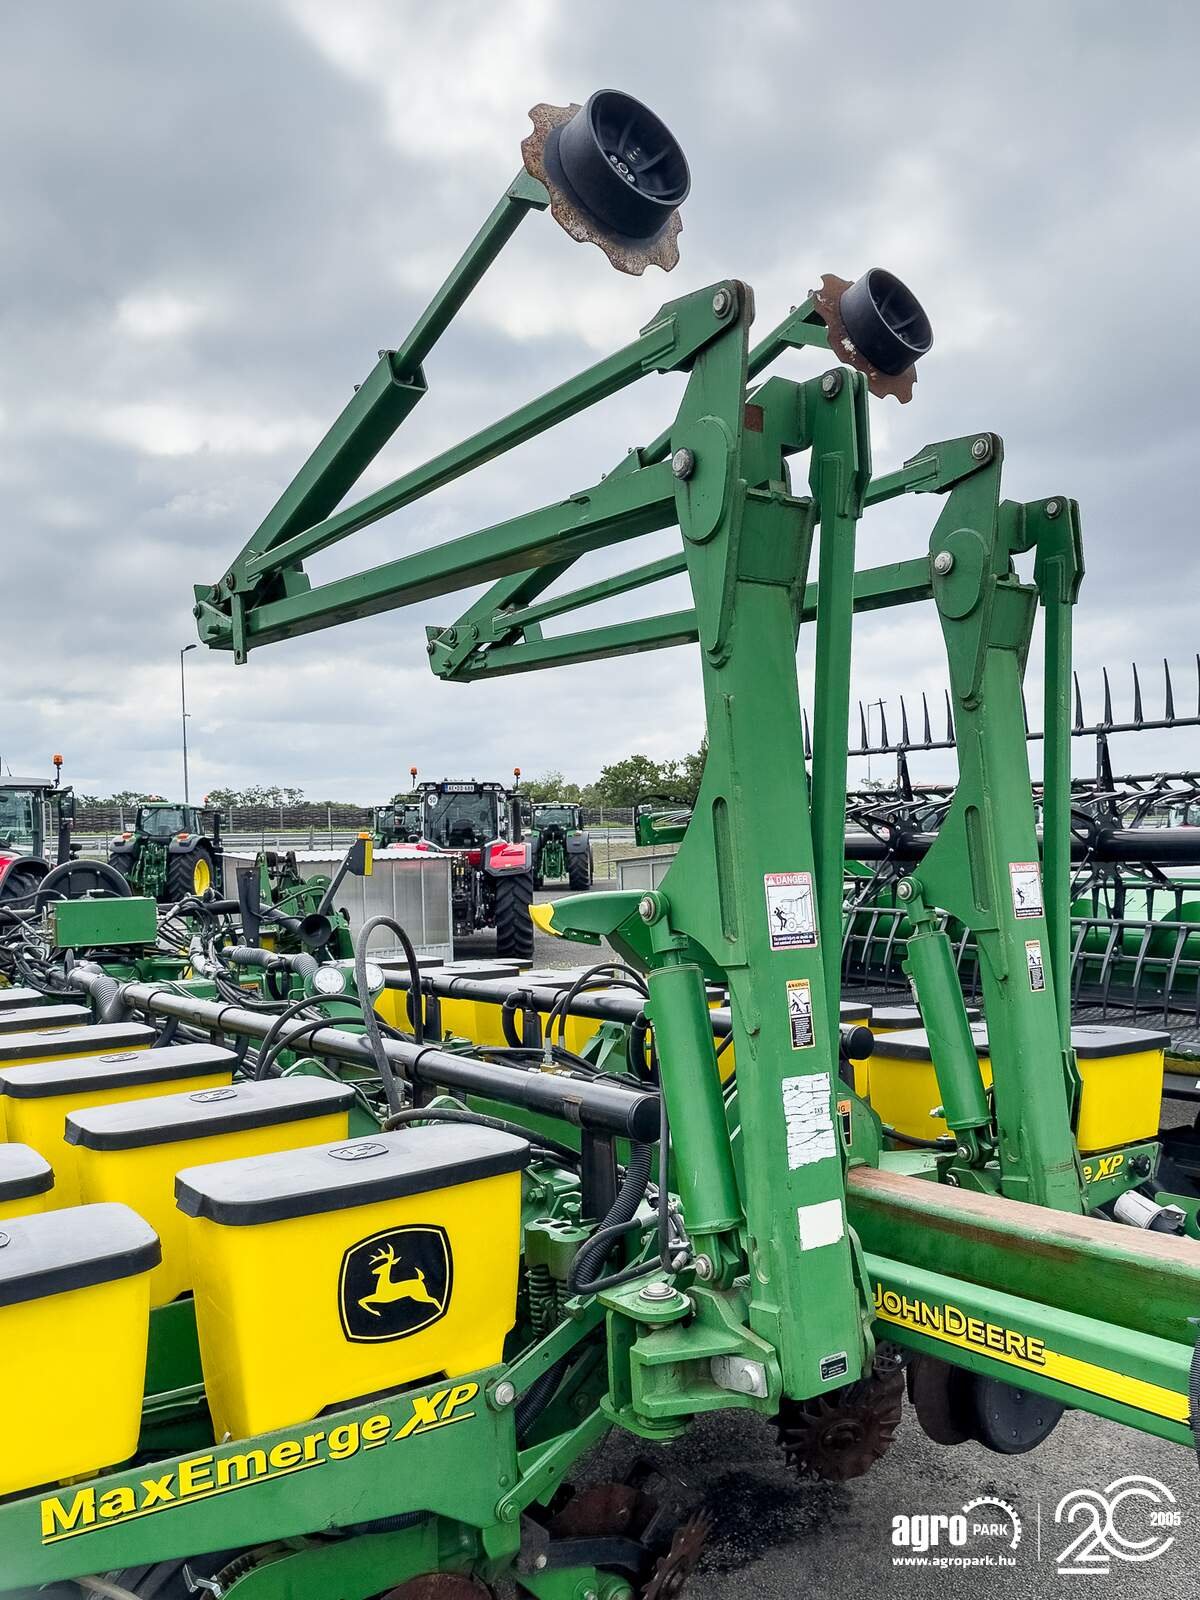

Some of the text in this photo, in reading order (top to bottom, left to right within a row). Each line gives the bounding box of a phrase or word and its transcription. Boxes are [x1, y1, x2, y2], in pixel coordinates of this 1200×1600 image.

[776, 874, 808, 885] DANGER
[872, 1283, 1046, 1365] JOHN DEERE
[40, 1382, 479, 1537] MaxEmerge XP
